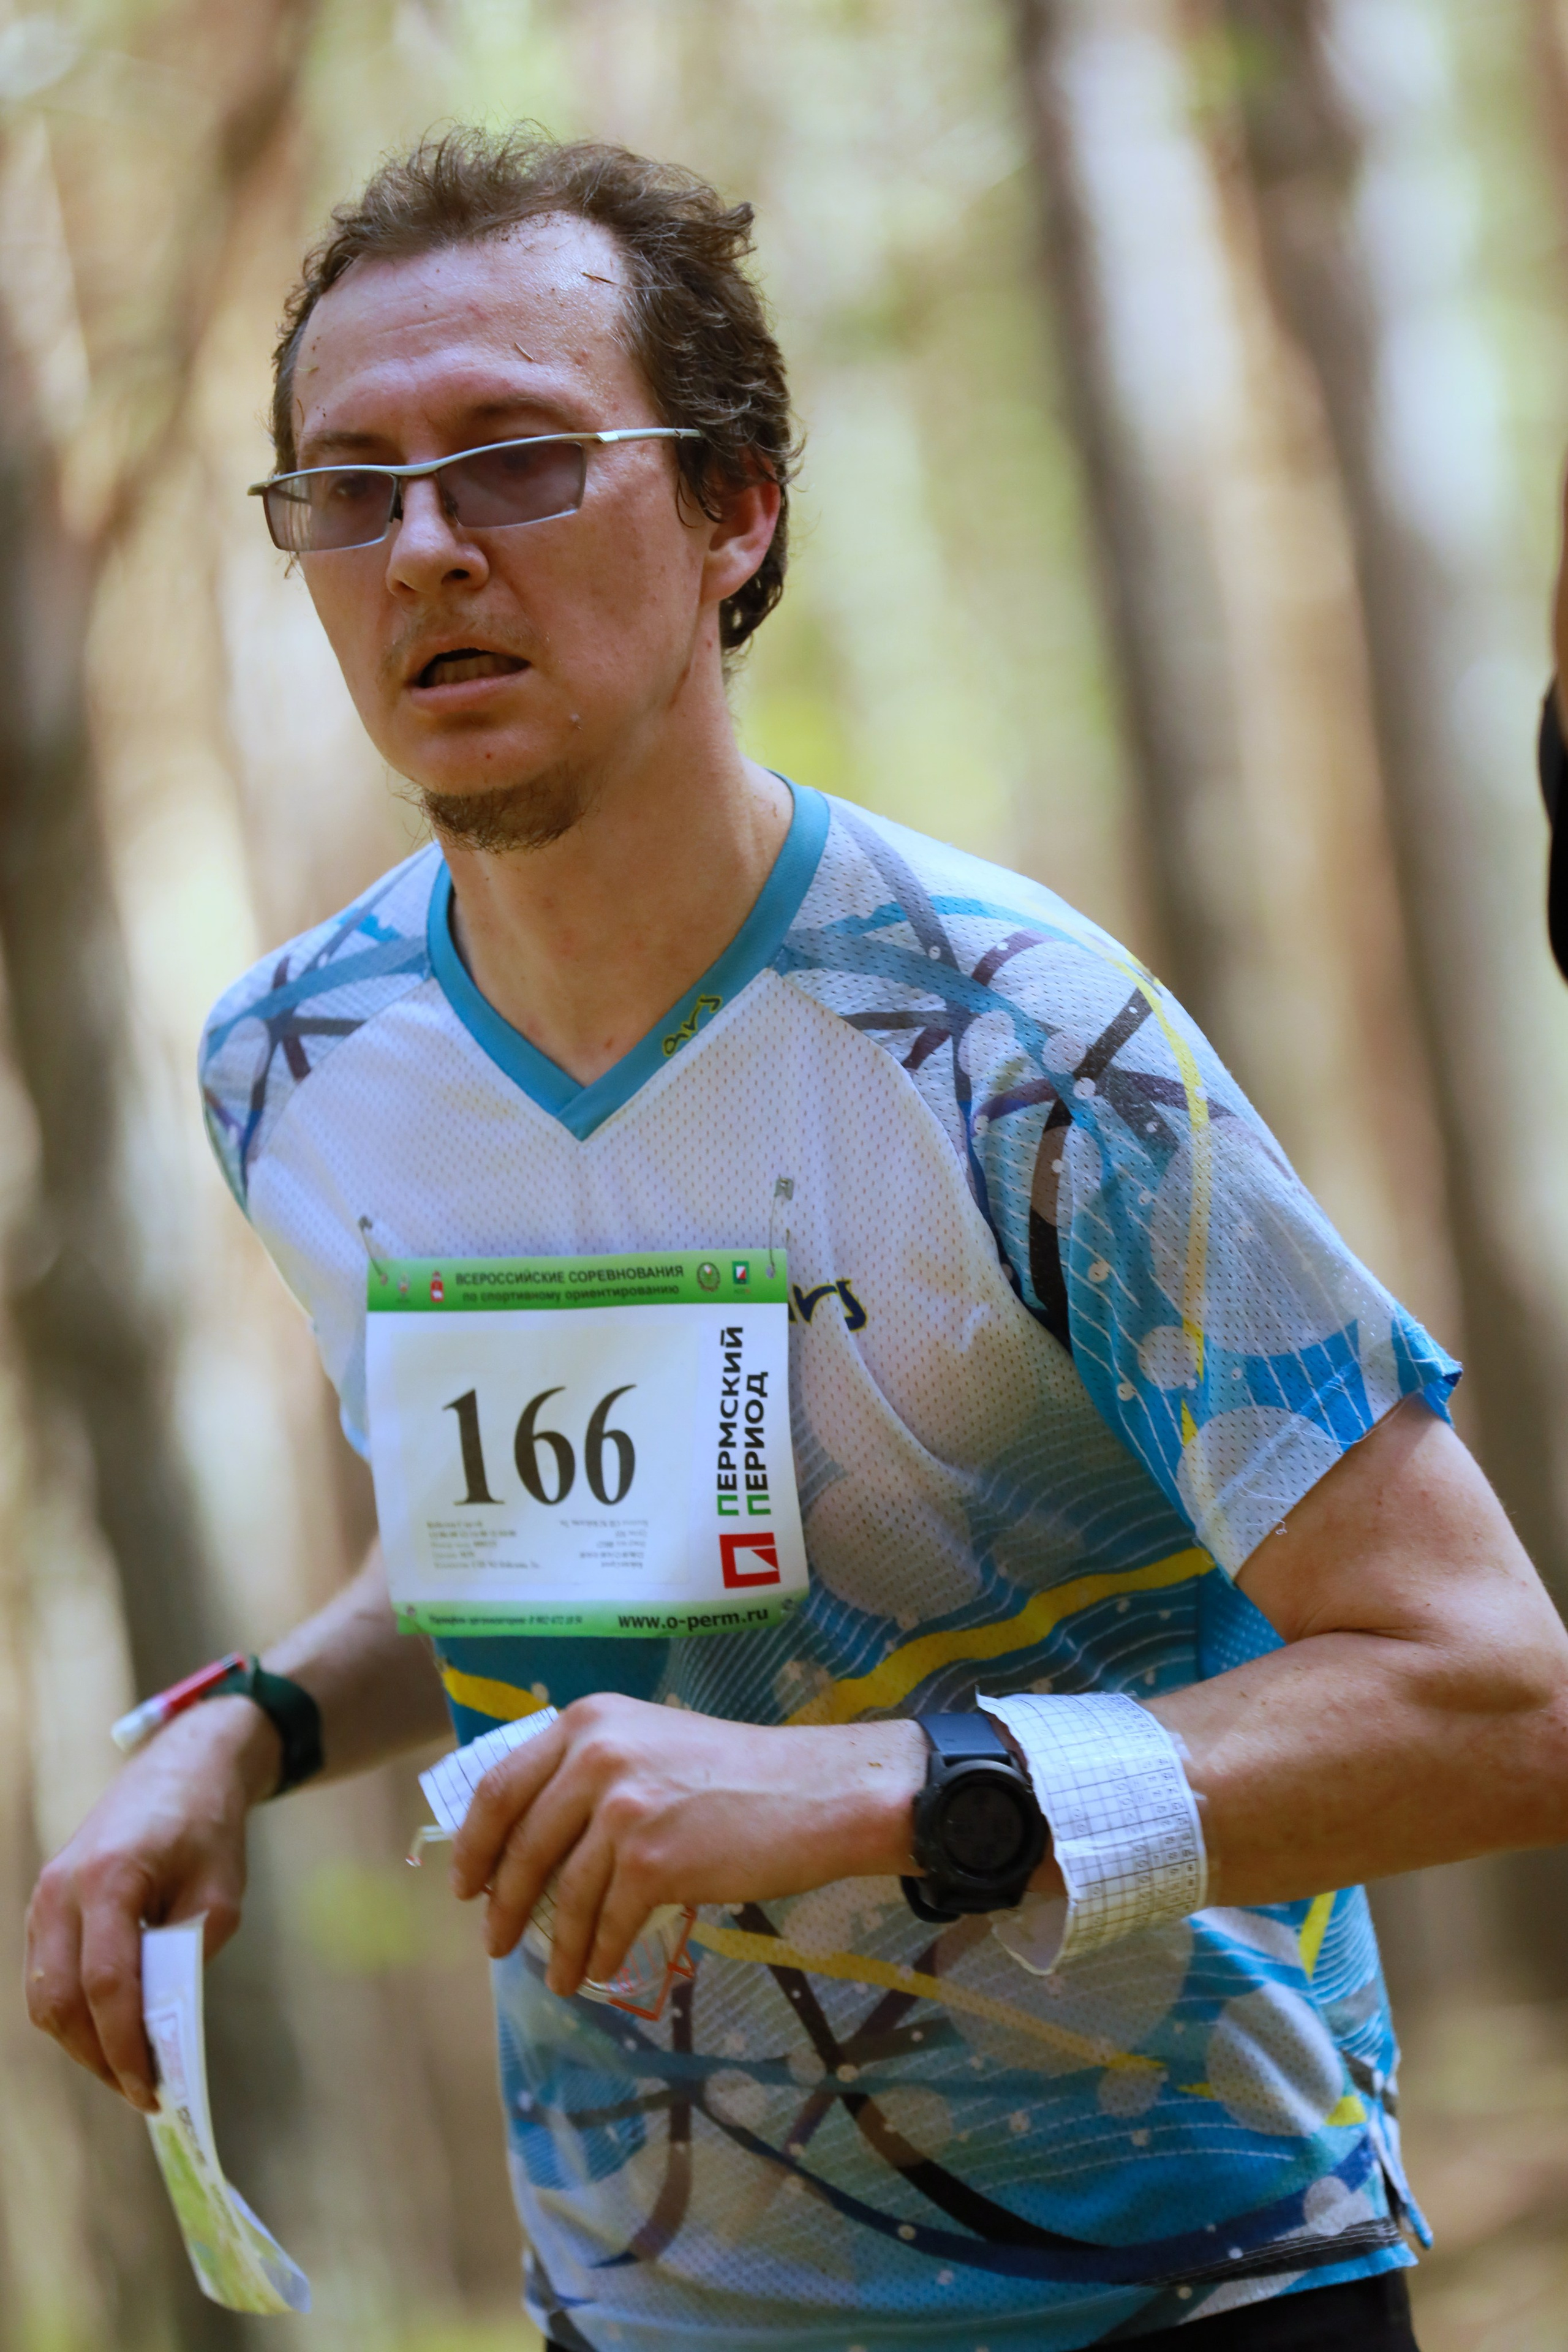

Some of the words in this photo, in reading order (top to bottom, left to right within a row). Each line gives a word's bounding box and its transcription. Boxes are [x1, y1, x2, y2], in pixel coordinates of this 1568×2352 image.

[456, 1269, 564, 1286] ВСЕРОССИЙСКИЕ
[568, 1265, 684, 1283] СОРЕВНОВАНИЯ
[565, 1284, 679, 1302] ориентированию
[442, 1384, 637, 1506] 166
[717, 1327, 743, 1516] ПЕРМСКИЙ
[744, 1371, 772, 1516] ПЕРИОД
[617, 1608, 769, 1632] www.o-perm.ru
